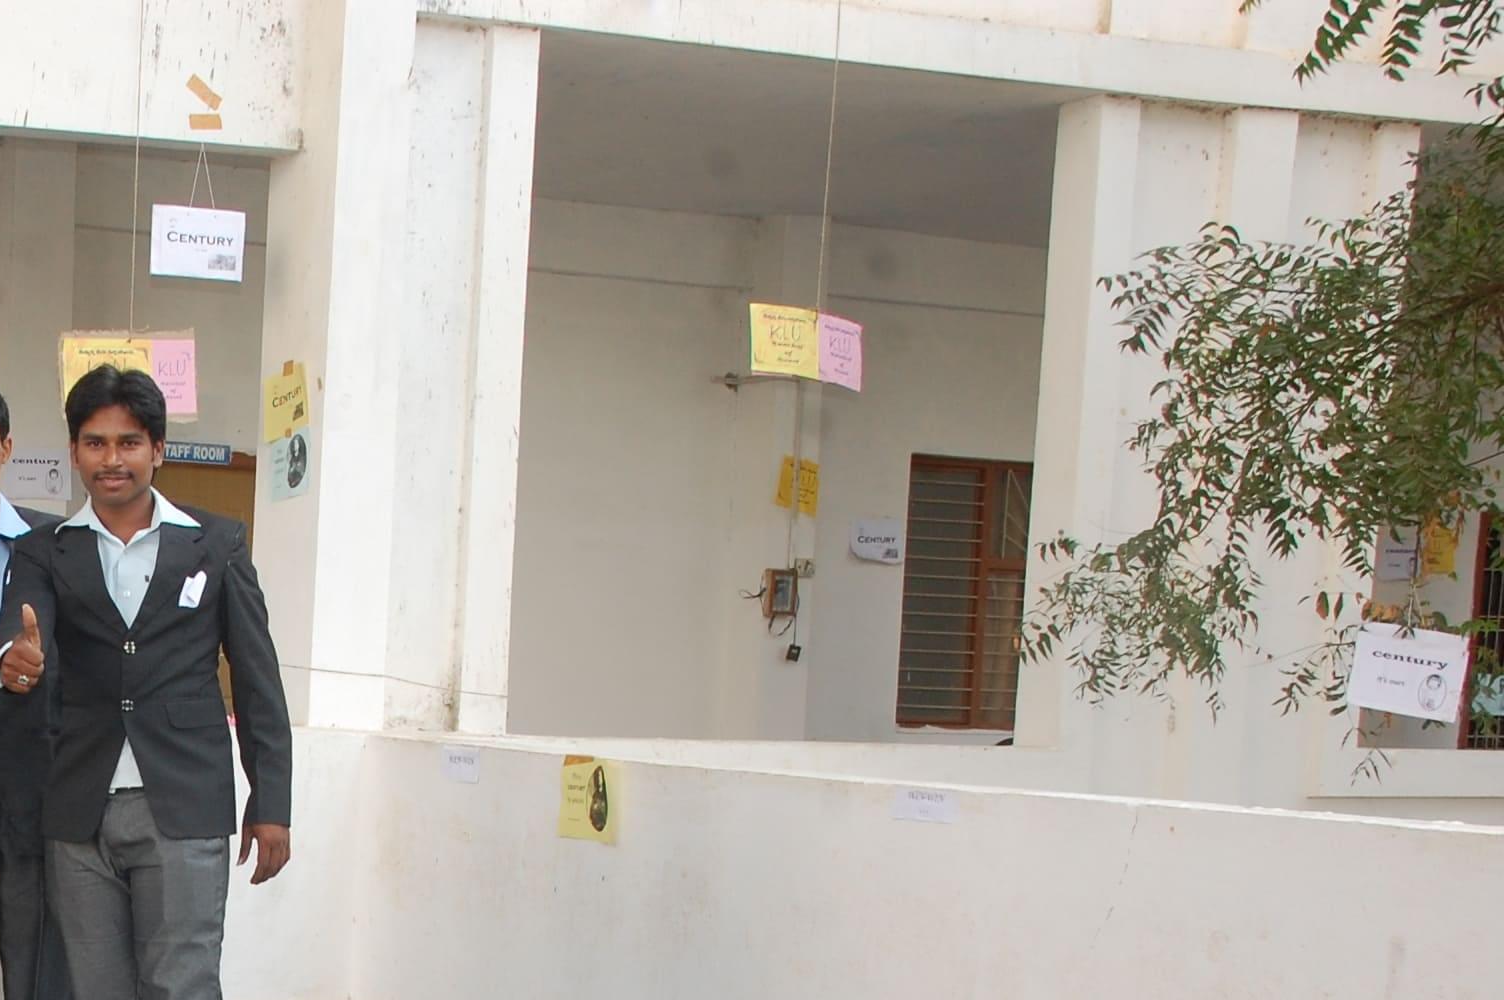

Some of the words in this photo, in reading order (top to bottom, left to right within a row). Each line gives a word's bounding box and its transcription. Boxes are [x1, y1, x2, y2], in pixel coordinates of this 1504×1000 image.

[12, 458, 60, 466] century
[164, 443, 191, 459] TAFF
[193, 446, 226, 462] ROOM
[1372, 649, 1449, 671] century
